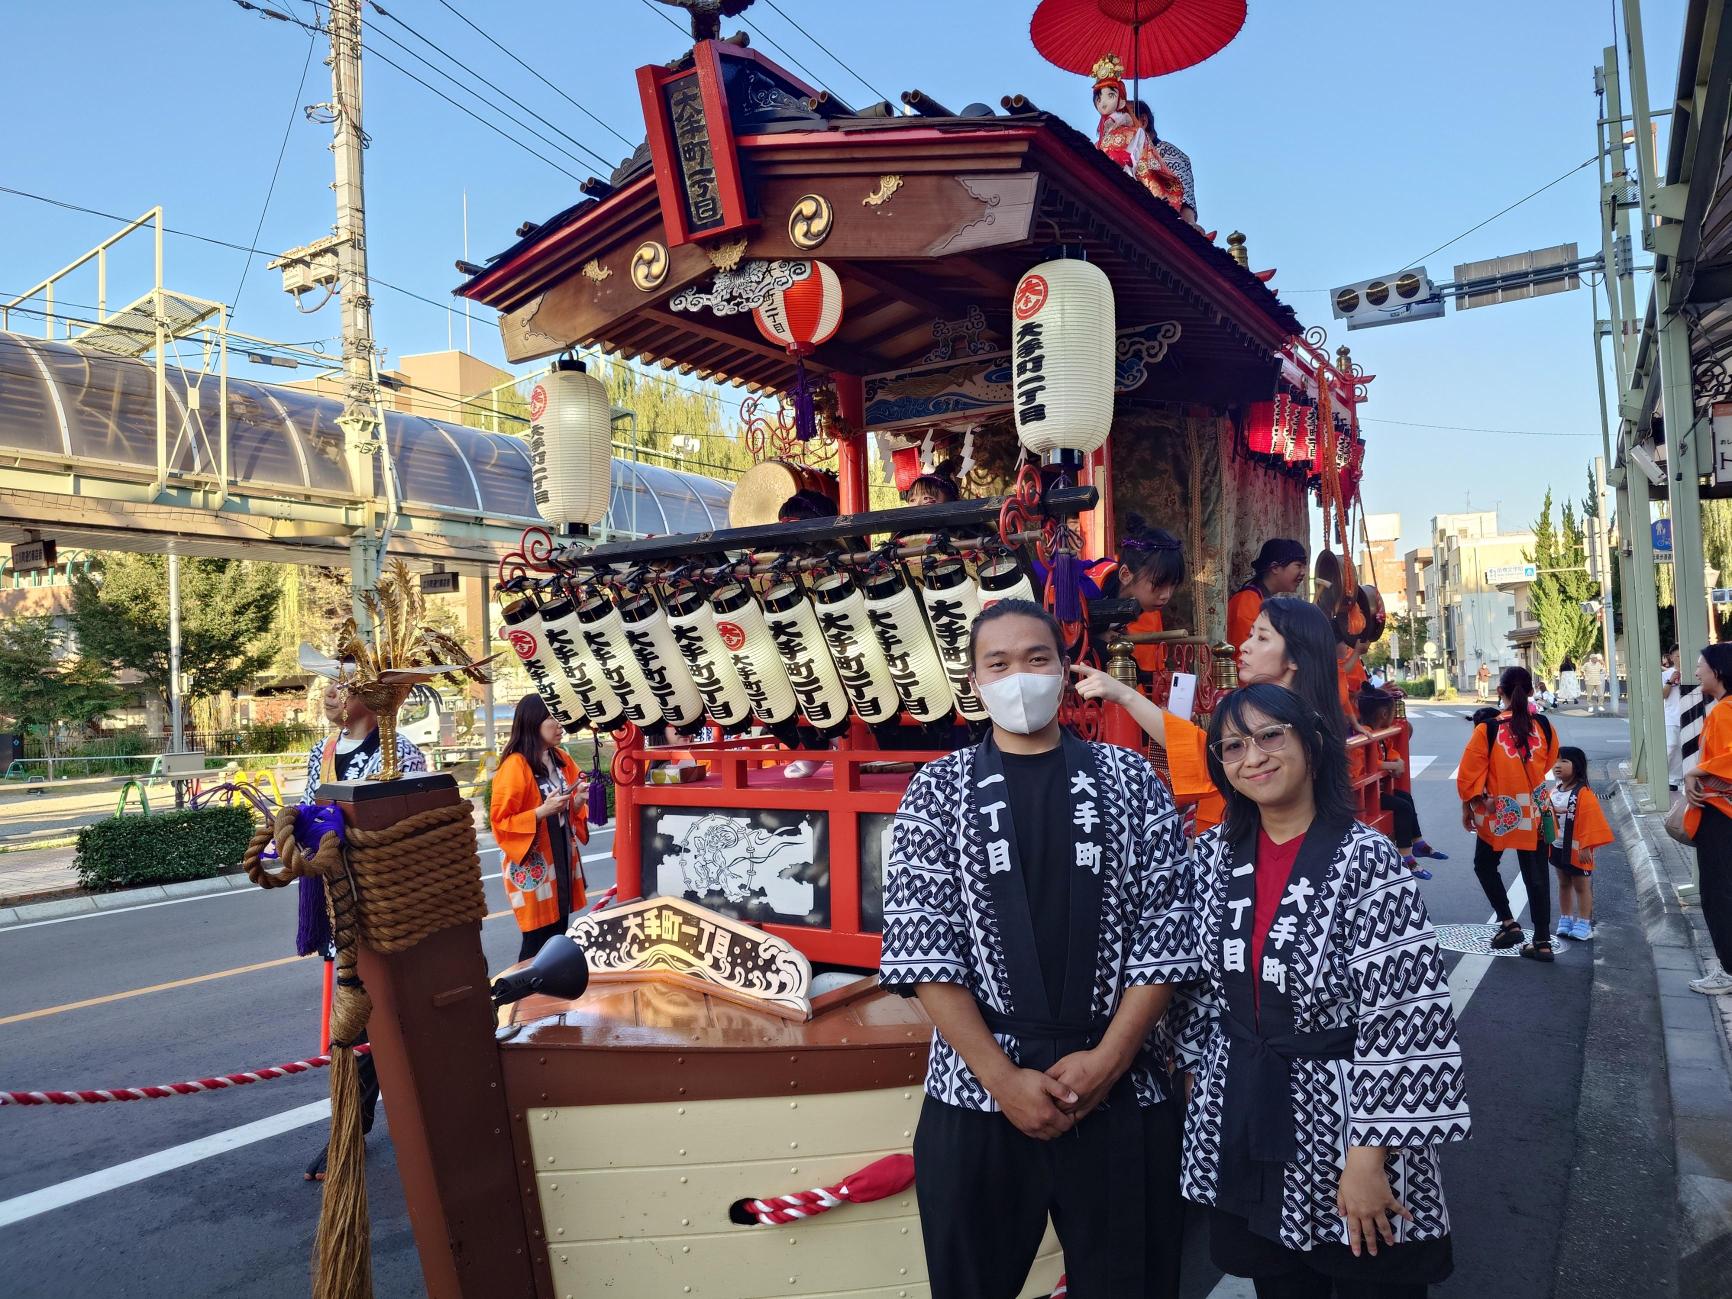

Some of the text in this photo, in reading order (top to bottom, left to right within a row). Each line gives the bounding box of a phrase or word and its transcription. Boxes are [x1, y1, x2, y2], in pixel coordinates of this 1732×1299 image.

[1016, 321, 1047, 426] 大手町一丁目
[523, 659, 573, 722] 大手町一丁目
[545, 629, 607, 718] 大手町一丁目
[582, 631, 646, 720] 大手町一丁目
[625, 630, 685, 722] 大手町一丁目
[671, 625, 734, 720] 大手町一丁目
[731, 654, 775, 720] 大手町一丁目
[768, 620, 832, 721] 大手町一丁目
[819, 612, 882, 717] 大手町一丁目
[867, 609, 930, 716] 大手町一丁目
[976, 773, 1012, 875] 一丁目
[1070, 770, 1103, 875] 大手町
[622, 907, 733, 961] 大手町一丁目
[1222, 862, 1255, 973] 一丁目
[1261, 876, 1315, 994] 大手町
